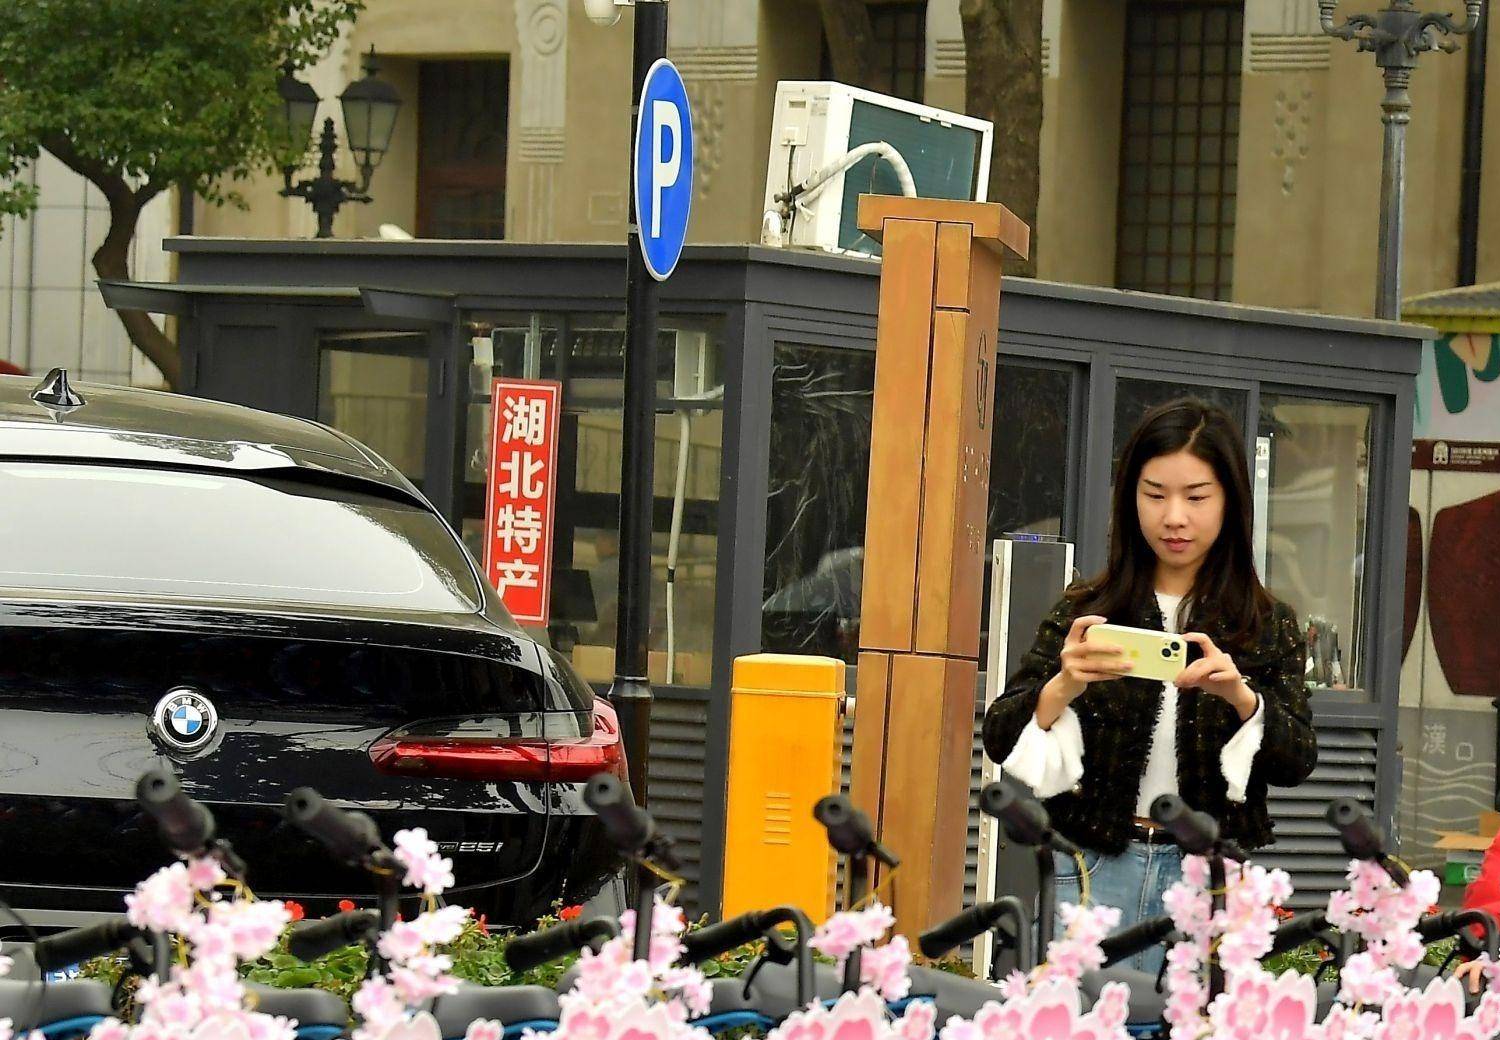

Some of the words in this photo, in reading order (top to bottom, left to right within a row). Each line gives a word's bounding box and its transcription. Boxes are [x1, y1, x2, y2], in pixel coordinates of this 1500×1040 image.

[651, 100, 682, 239] P
[496, 396, 547, 600] 湖北特产
[167, 697, 208, 714] BMW
